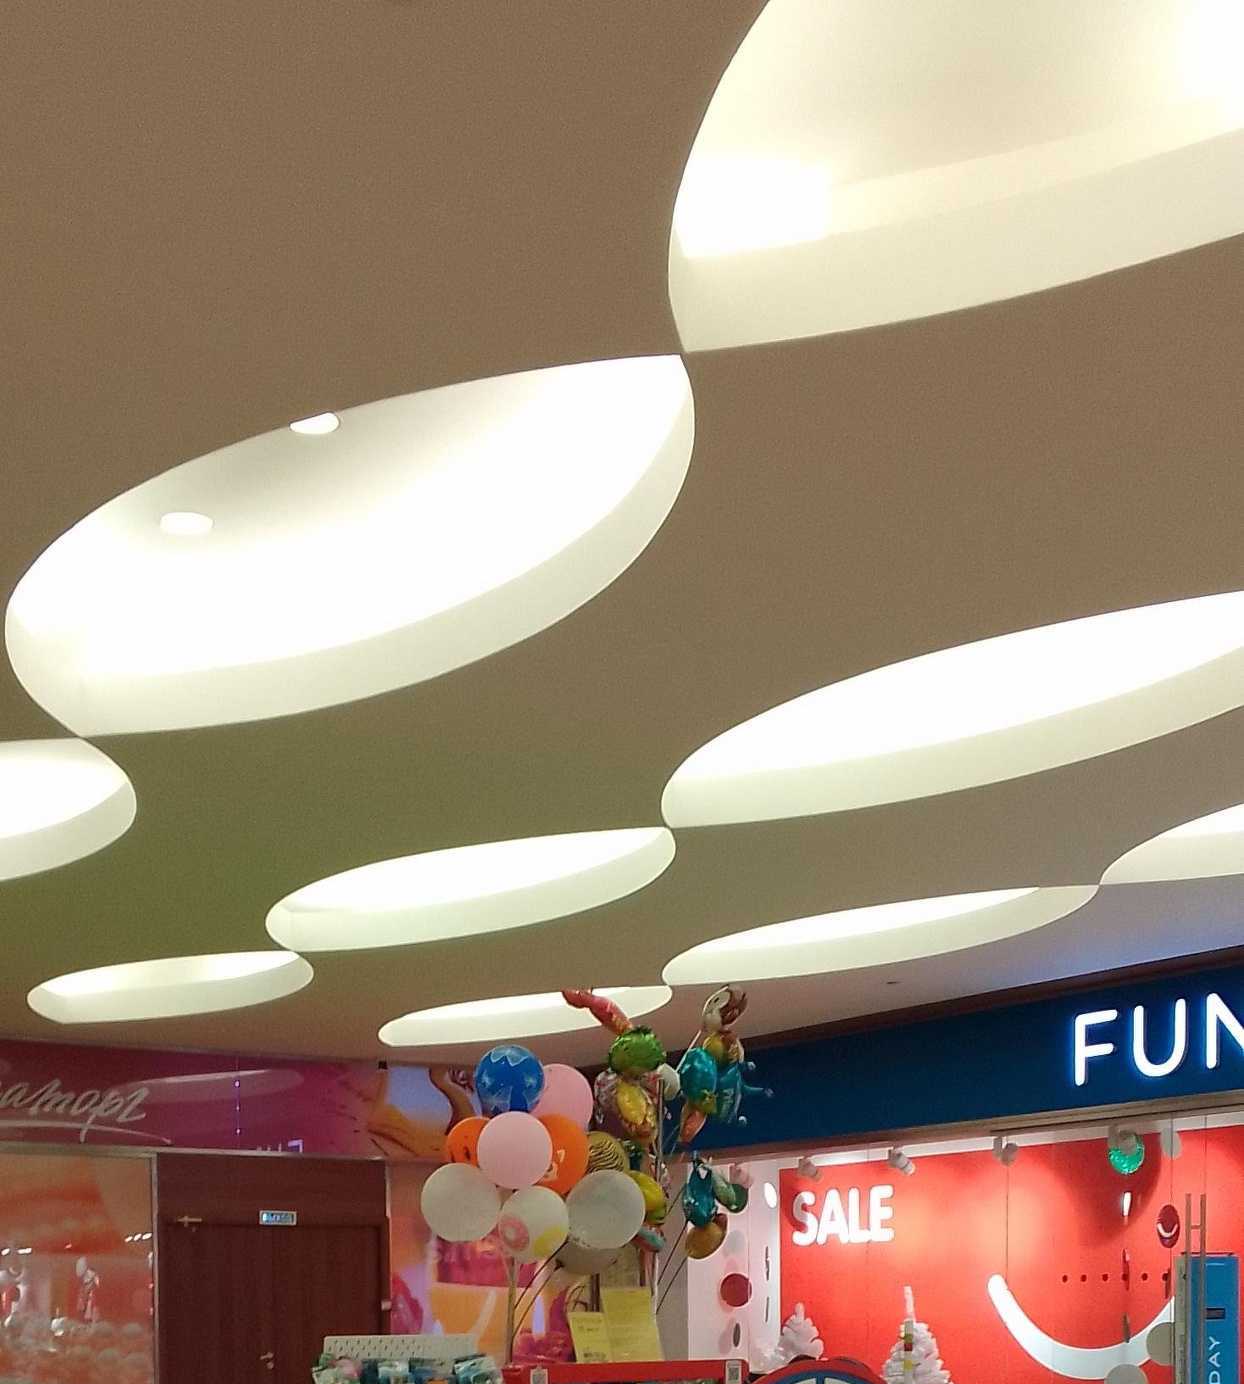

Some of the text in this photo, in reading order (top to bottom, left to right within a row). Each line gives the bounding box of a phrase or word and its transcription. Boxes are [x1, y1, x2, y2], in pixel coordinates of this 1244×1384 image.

[1074, 992, 1244, 1086] FUN
[0, 1078, 150, 1142] аторг
[792, 1184, 895, 1246] SALE
